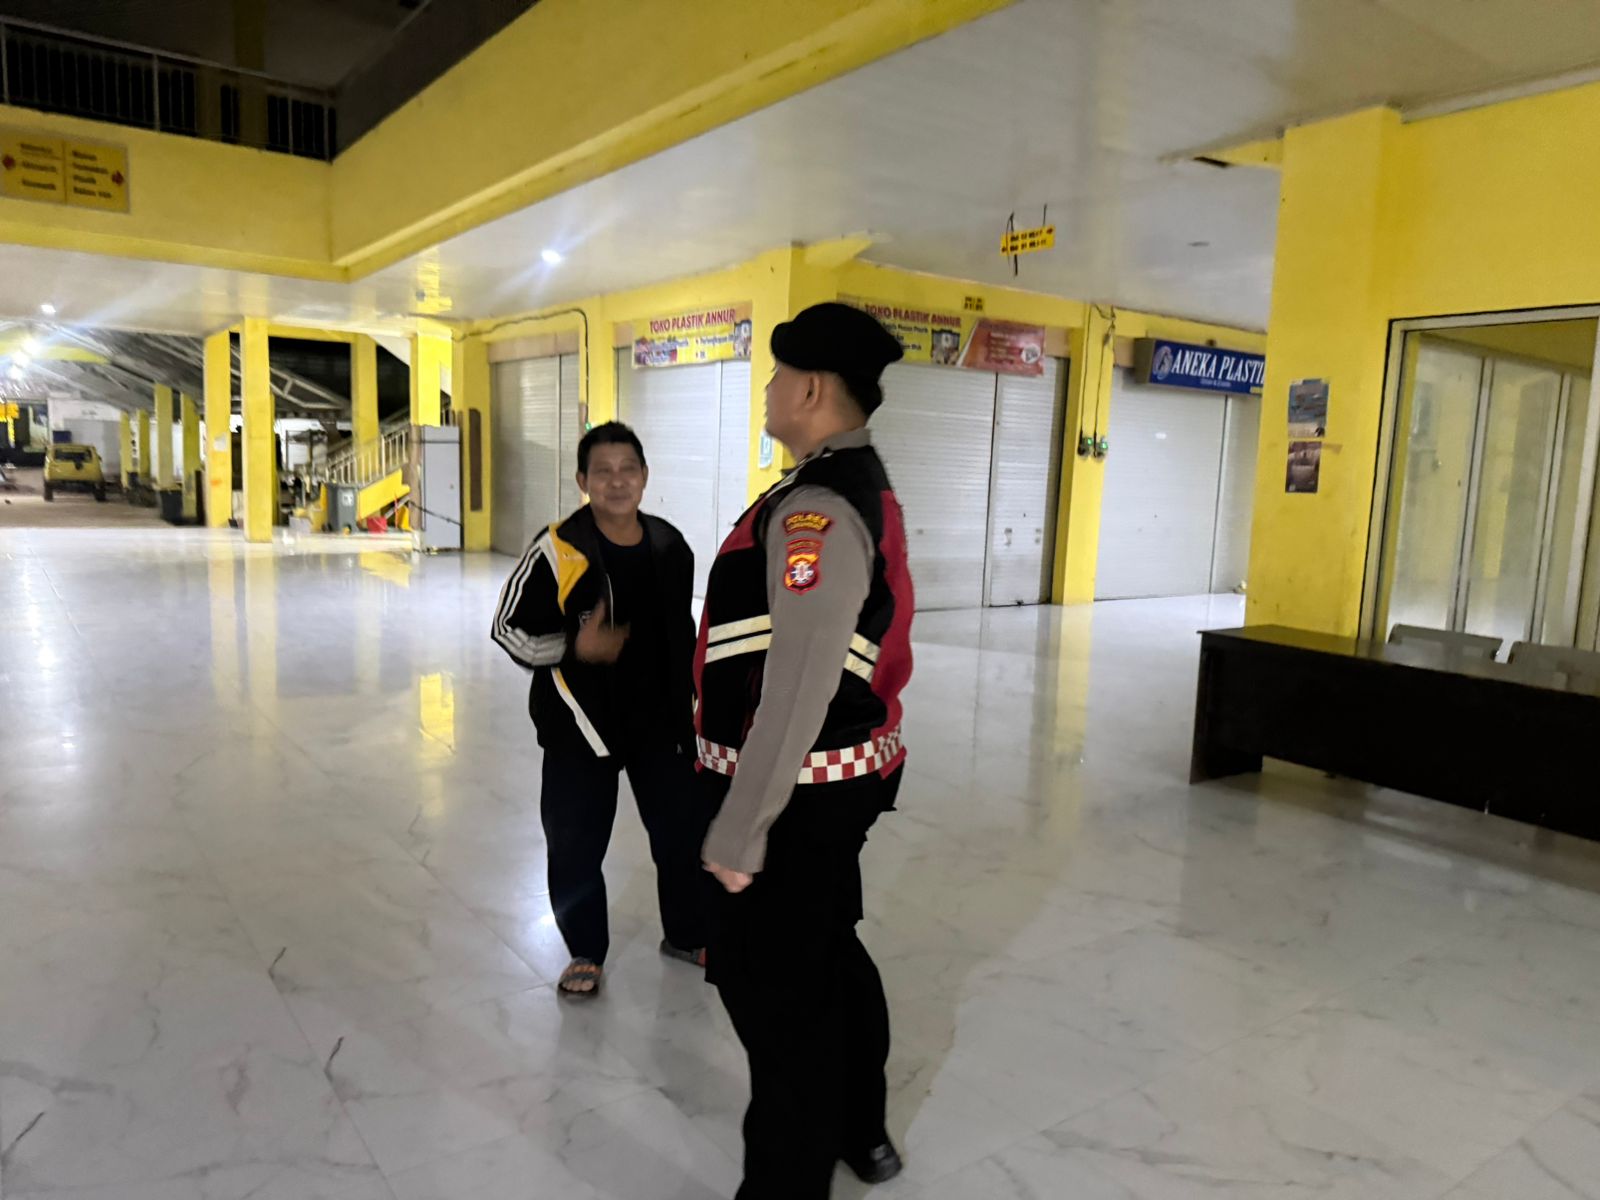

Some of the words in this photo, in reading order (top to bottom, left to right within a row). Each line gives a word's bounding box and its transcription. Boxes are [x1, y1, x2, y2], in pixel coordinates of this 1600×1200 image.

[649, 319, 671, 334] TOKO
[671, 314, 705, 331] PLASTIK
[705, 308, 736, 325] ANNUR
[864, 303, 892, 319] TOKO
[893, 307, 931, 323] PLASTIK
[931, 313, 962, 328] ANNUR
[1171, 349, 1218, 379] ANEKA
[1218, 355, 1265, 385] PLASTI
